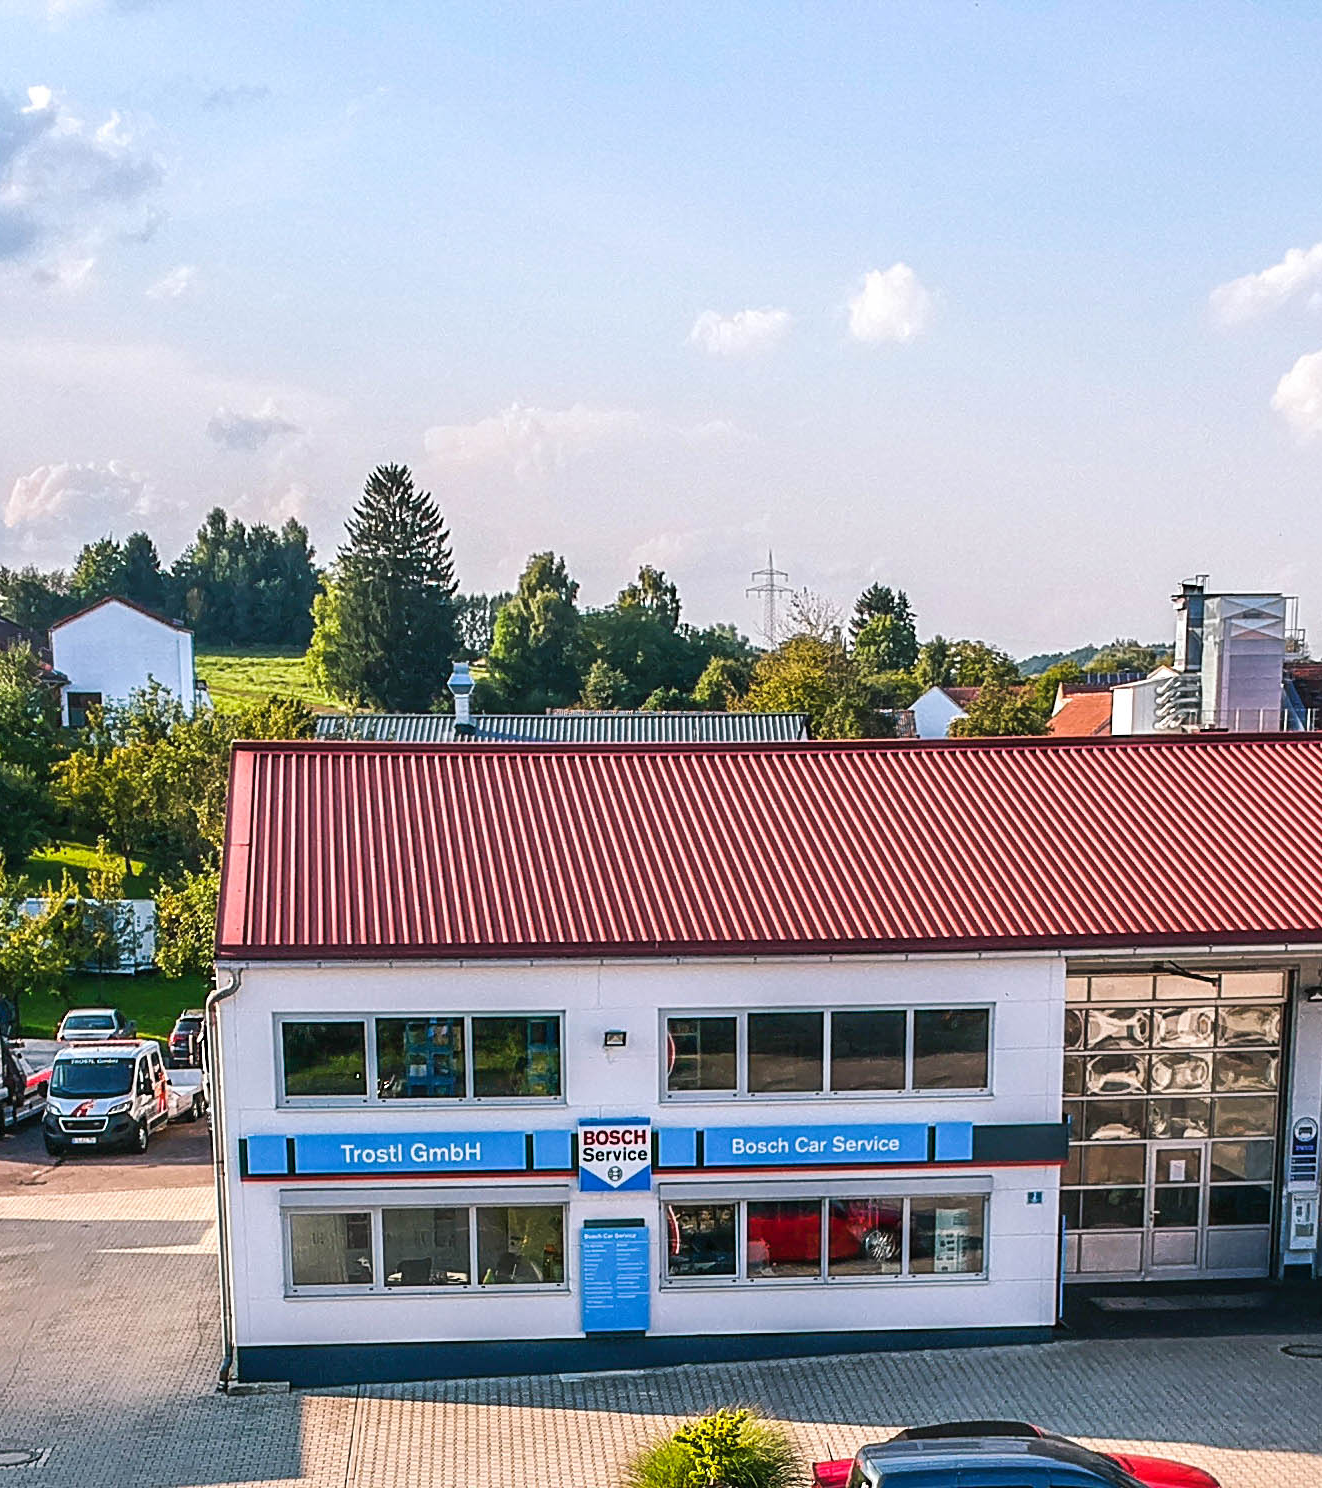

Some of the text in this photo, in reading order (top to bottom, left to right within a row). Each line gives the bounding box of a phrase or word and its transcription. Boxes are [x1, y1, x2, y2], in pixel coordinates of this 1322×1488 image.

[583, 1129, 647, 1146] BOSCH
[732, 1135, 900, 1155] Bosch Car Service
[340, 1142, 481, 1163] Trostl GmbH
[582, 1146, 648, 1163] Service
